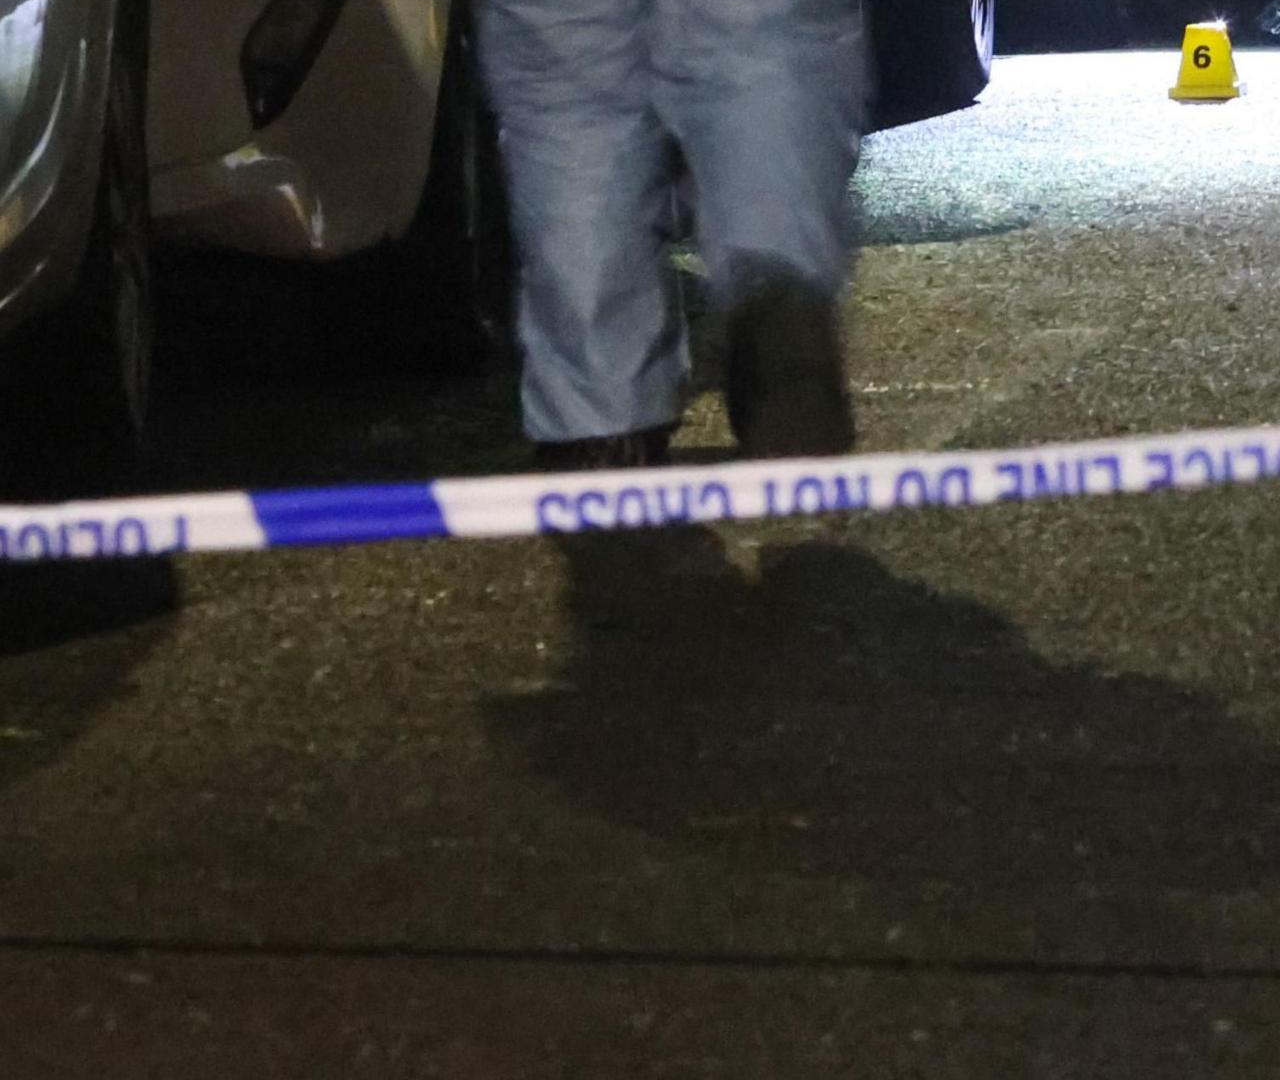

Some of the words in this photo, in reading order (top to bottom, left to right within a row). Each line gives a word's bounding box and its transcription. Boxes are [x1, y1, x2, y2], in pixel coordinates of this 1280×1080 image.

[1193, 45, 1211, 69] 6
[763, 474, 871, 515] NOT
[892, 464, 974, 506] DO
[995, 453, 1124, 500] LINE
[534, 480, 736, 533] CROSS
[0, 516, 190, 557] POLIC
